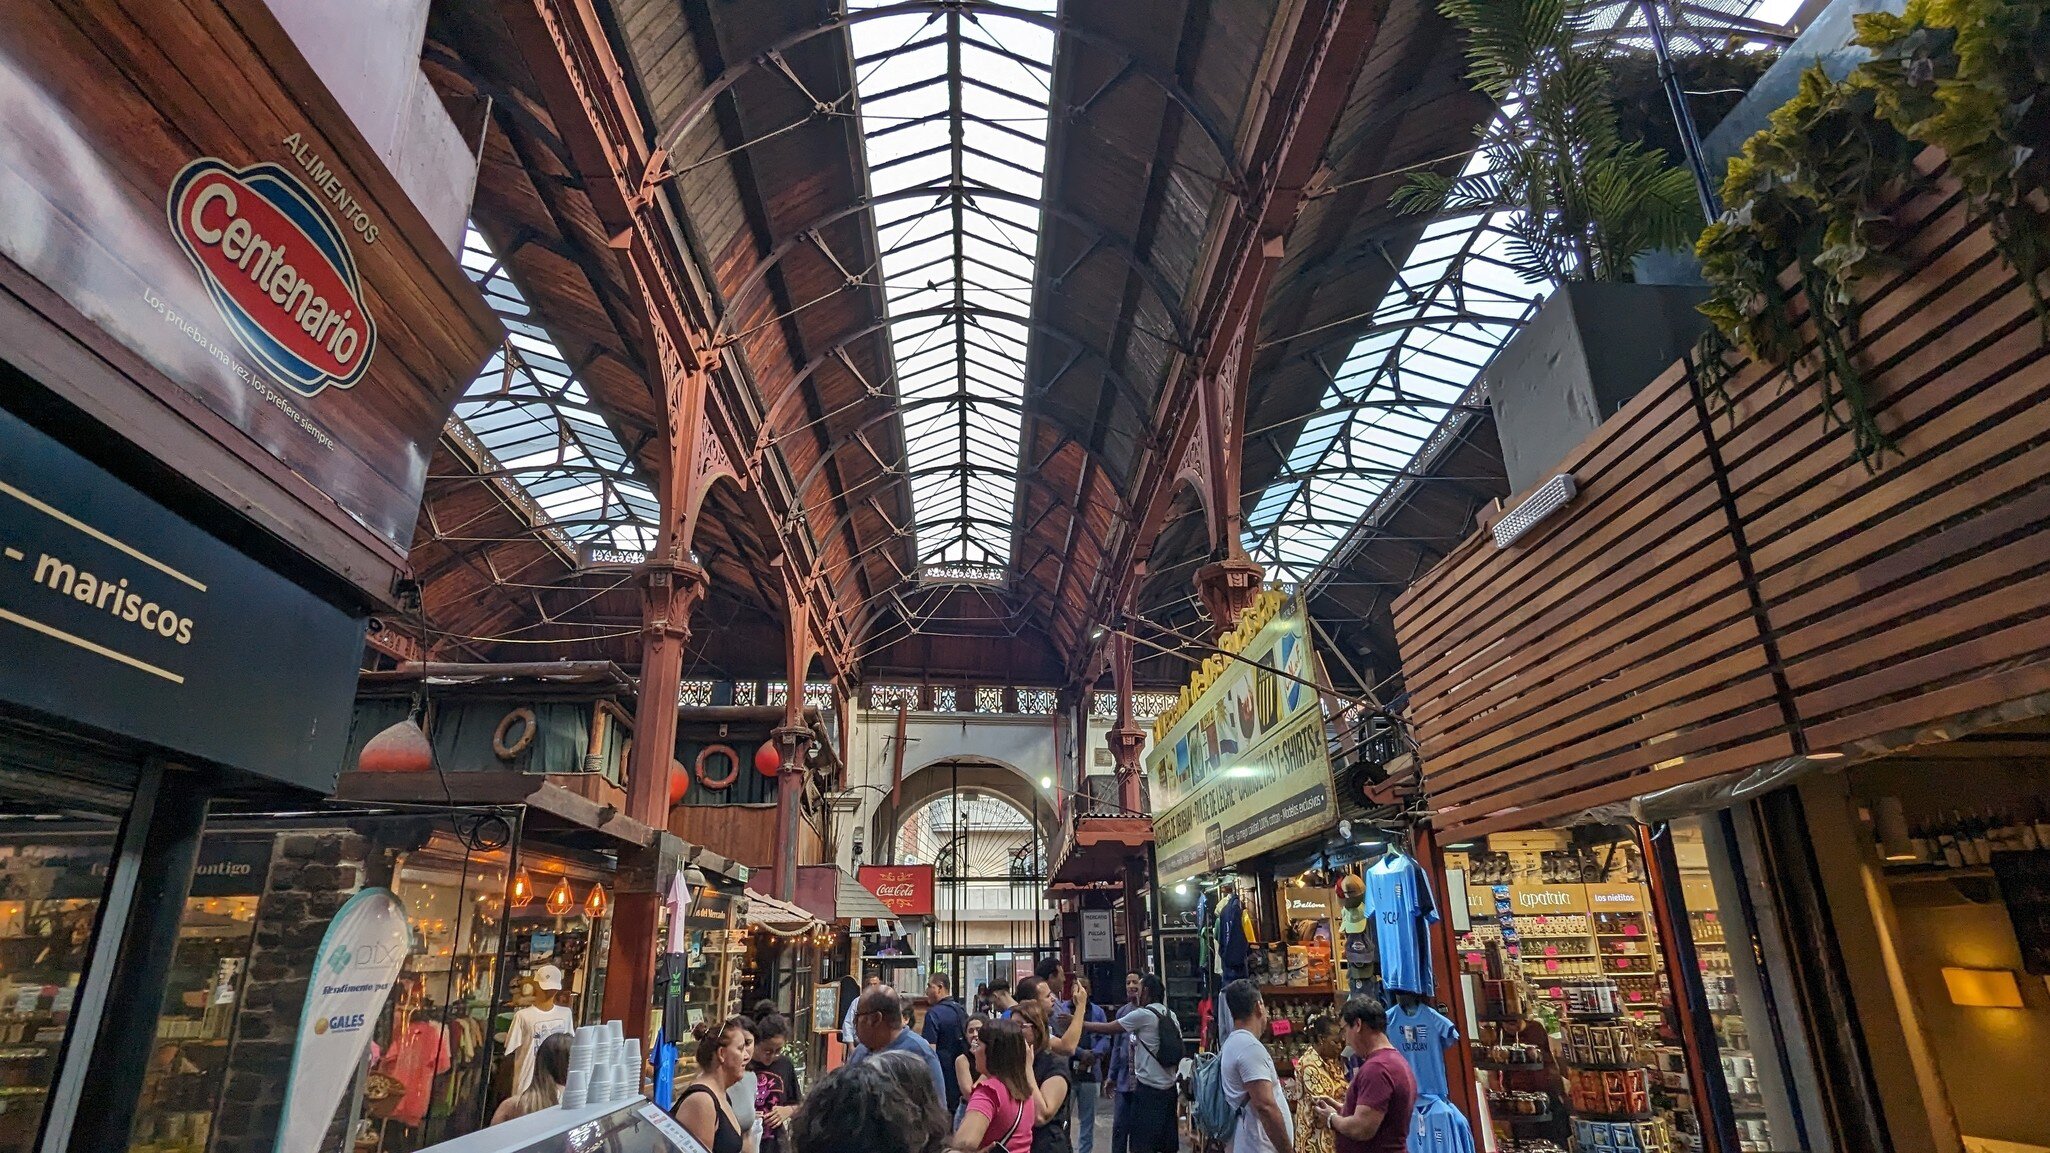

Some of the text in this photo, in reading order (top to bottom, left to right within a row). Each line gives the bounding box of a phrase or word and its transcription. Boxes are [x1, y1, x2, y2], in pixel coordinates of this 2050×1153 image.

[283, 133, 379, 243] ALIMENTOS
[191, 182, 359, 365] Centenario
[143, 288, 335, 451] Los prueba una vez, los prefiere siempre.
[33, 553, 194, 645] mariscos
[1274, 724, 1316, 778] T-SHIRTS
[329, 1013, 365, 1029] GALES
[1402, 1042, 1428, 1052] URUGUAY
